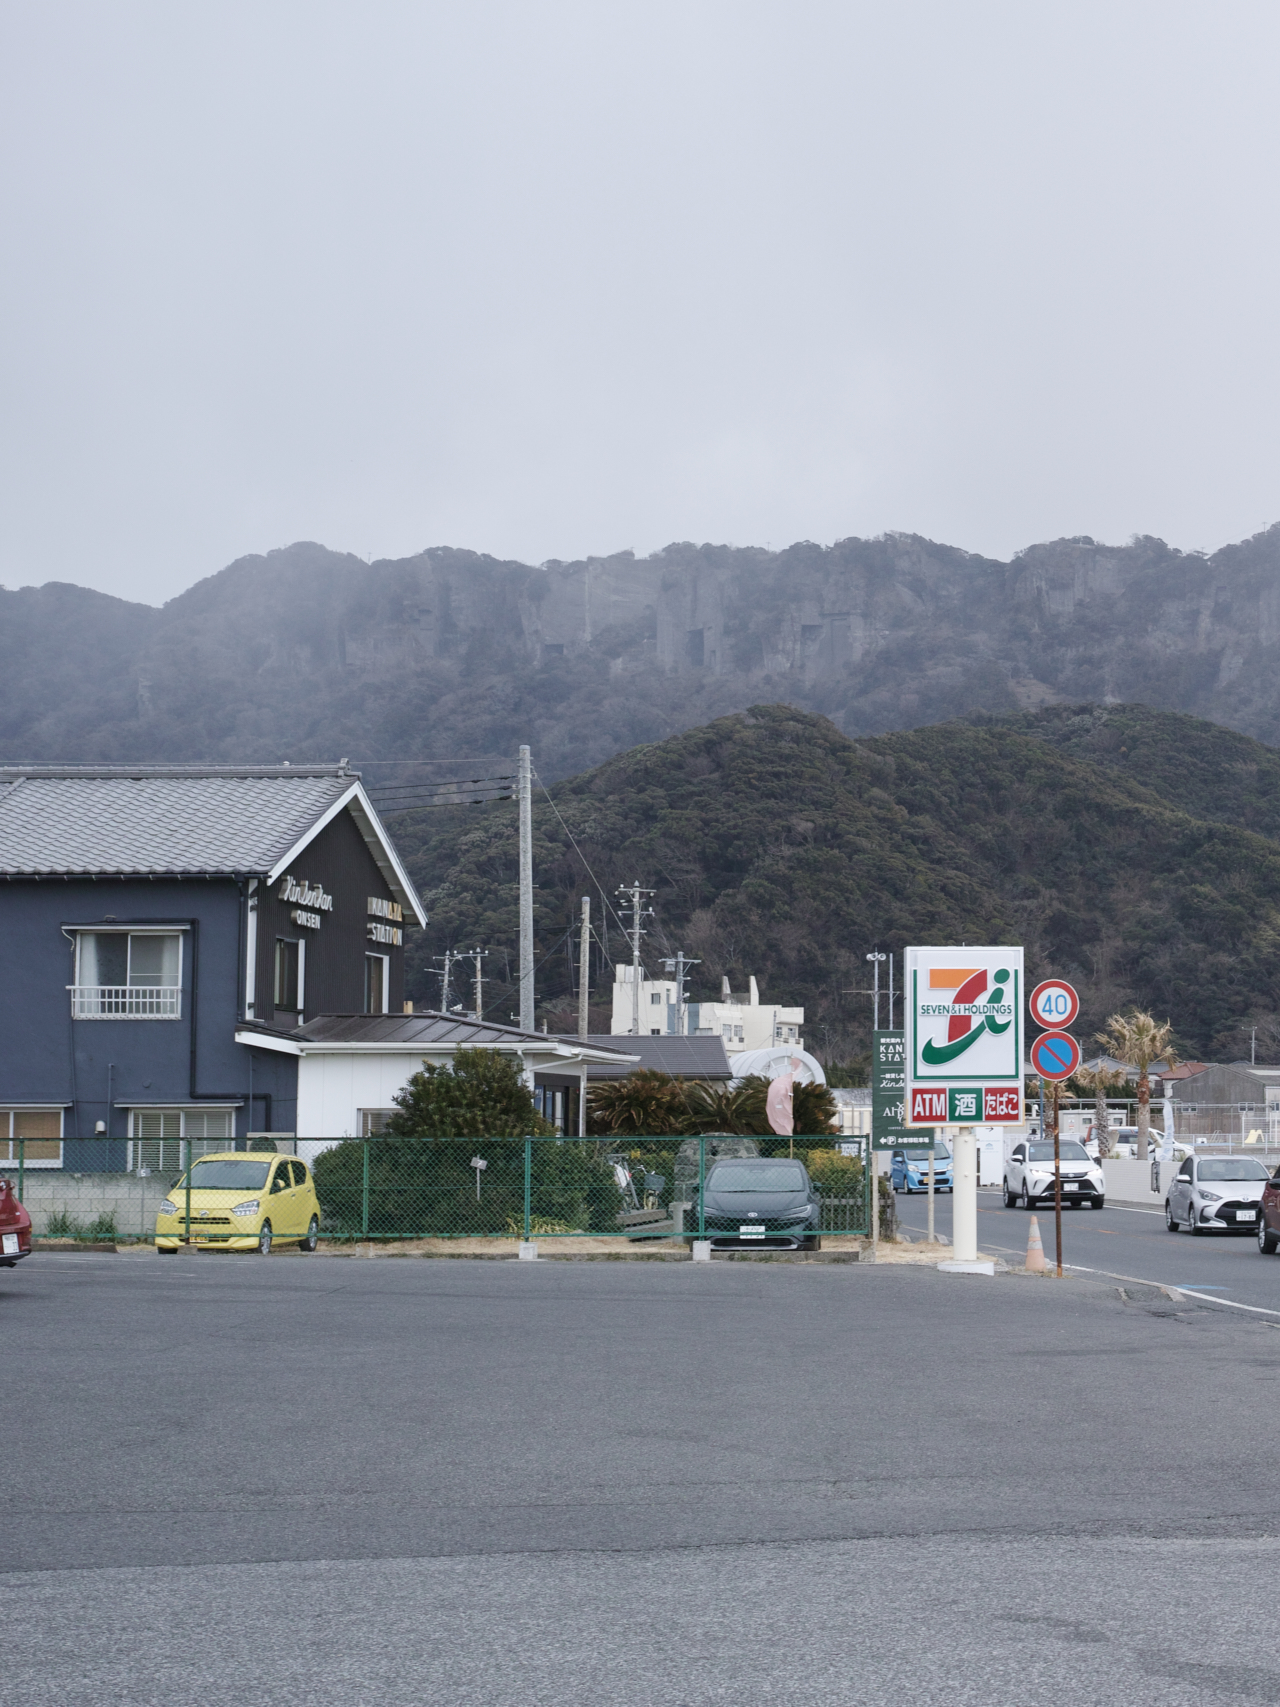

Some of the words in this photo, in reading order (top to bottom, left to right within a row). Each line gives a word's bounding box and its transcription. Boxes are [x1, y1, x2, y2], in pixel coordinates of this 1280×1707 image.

[296, 910, 321, 929] ONSEN
[372, 897, 402, 921] KANAYA
[371, 922, 402, 946] STATION
[963, 1004, 1012, 1014] HOLDINGS
[1042, 994, 1067, 1015] 40
[913, 1094, 945, 1116] ATM
[955, 1094, 977, 1116] 酒
[985, 1093, 1018, 1115] たばこ
